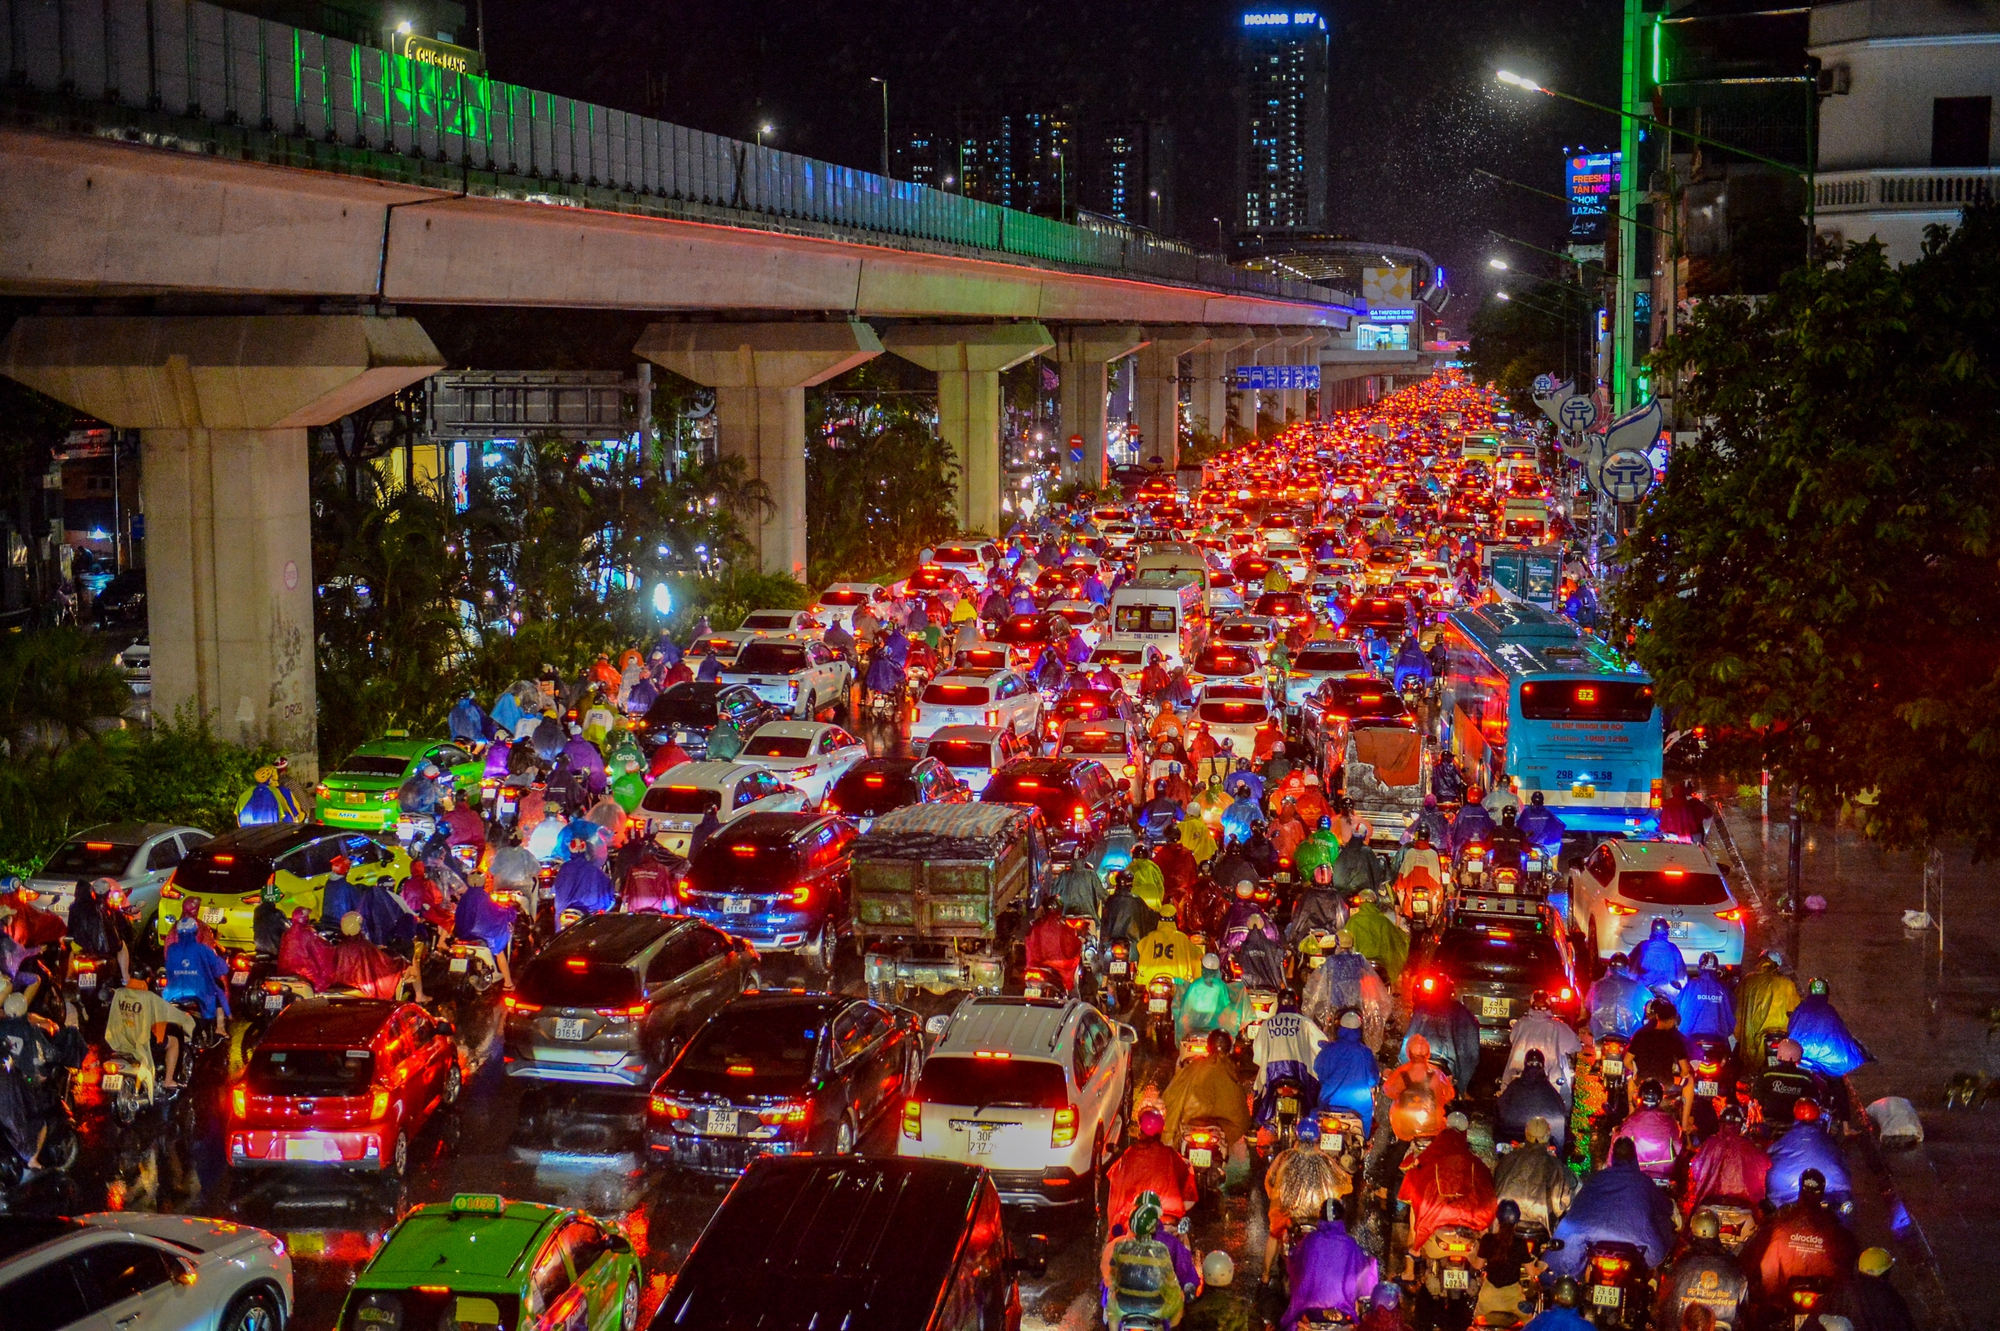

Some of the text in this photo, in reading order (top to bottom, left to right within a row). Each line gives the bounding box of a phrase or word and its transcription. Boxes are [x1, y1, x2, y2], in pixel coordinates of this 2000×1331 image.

[284, 702, 303, 719] DR29
[616, 753, 636, 761] Grab
[1556, 770, 1573, 779] 29B
[1153, 939, 1174, 960] be
[562, 1019, 576, 1028] 30F
[1267, 1016, 1300, 1028] nutri
[1772, 1080, 1803, 1095] Ricons
[715, 1112, 731, 1122] 29A
[977, 1131, 993, 1141] 30F
[467, 1197, 497, 1210] 1055
[1790, 1234, 1824, 1244] airocide
